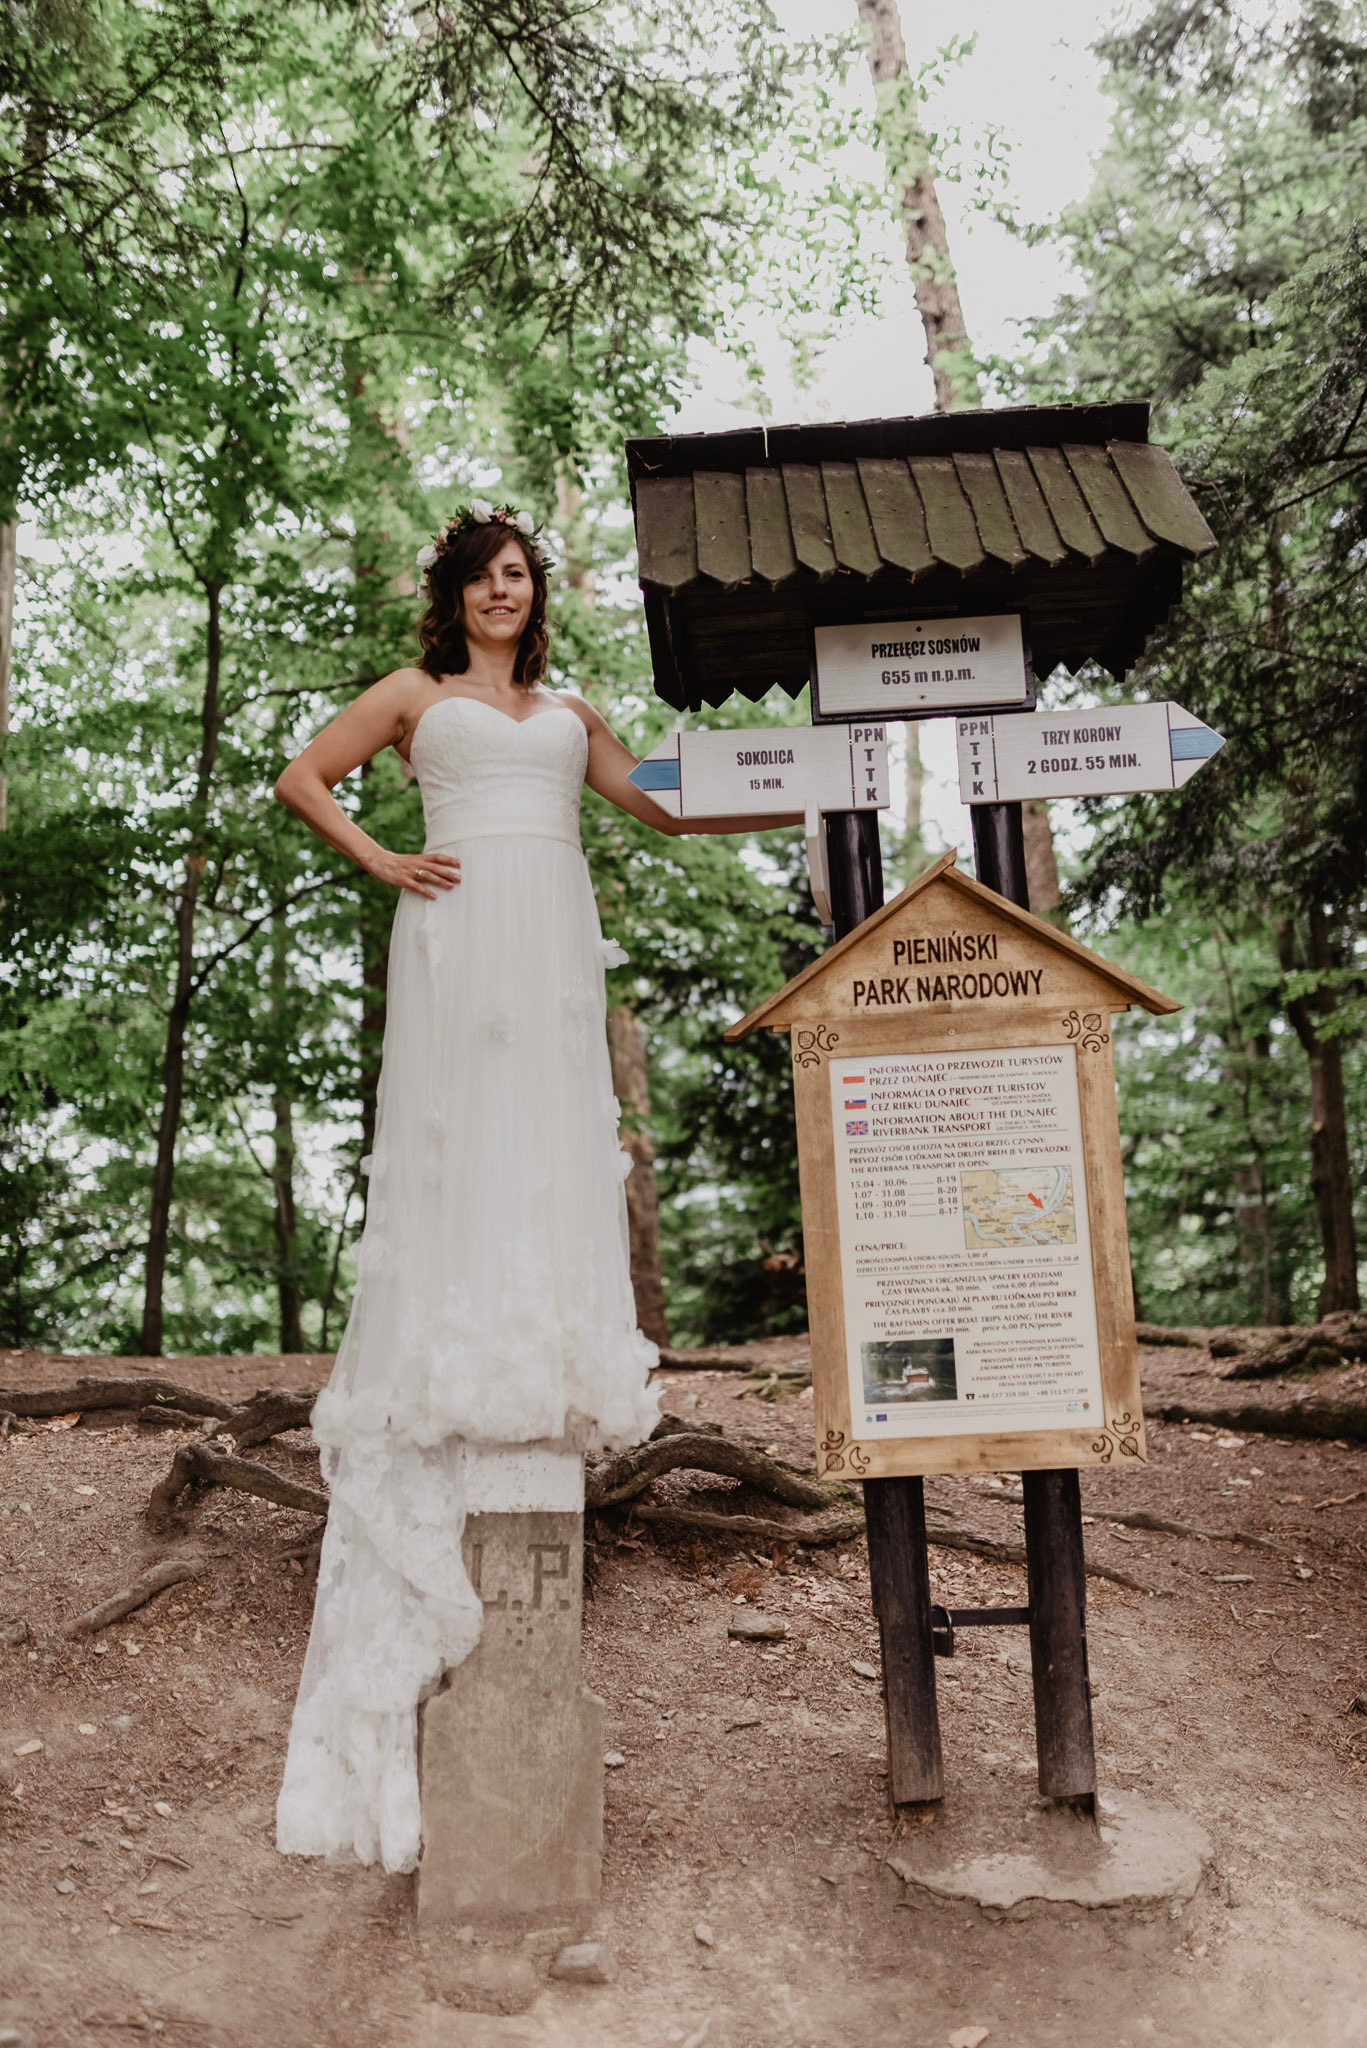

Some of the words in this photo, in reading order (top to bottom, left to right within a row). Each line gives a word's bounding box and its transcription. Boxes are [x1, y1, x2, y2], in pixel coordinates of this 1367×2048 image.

[871, 640, 925, 659] PRZEŁĘCZ
[928, 634, 981, 655] SOSNÓW
[881, 670, 911, 685] 655
[914, 670, 928, 683] m
[931, 668, 975, 683] n.p.m.
[854, 728, 884, 742] PPN
[959, 721, 989, 736] PPN
[1042, 730, 1070, 746] TRZY
[1073, 726, 1122, 744] KORONY
[736, 750, 794, 766] SOKOLICA
[1027, 760, 1037, 774] 2
[1040, 757, 1083, 773] GODZ.
[1085, 756, 1105, 770] 55
[1109, 753, 1141, 769] MIN.
[749, 779, 760, 790] 15
[763, 778, 784, 789] MIN.
[893, 931, 998, 966] PIENIŃSKI
[853, 977, 911, 1006] PARK
[917, 969, 1043, 1002] NARODOWY
[869, 1063, 934, 1075] INFORMACJA
[936, 1063, 944, 1071] O
[948, 1059, 1005, 1070] PRZEWOZIE
[1008, 1054, 1064, 1067] TURYSTÓW
[870, 1076, 900, 1085] PRZEZ
[902, 1074, 948, 1084] DUNAJEC
[871, 1088, 935, 1100] INFORMÁCIA
[950, 1086, 993, 1096] PREVOZE
[996, 1083, 1046, 1093] TURISTOV
[871, 1102, 889, 1111] CEZ
[893, 1100, 921, 1110] RIEKU
[925, 1098, 971, 1108] DUNAJEC
[872, 1114, 945, 1126] INFORMATION
[950, 1112, 985, 1121] ABOUT
[988, 1111, 1007, 1119] THE
[1010, 1108, 1058, 1118] DUNAJEC
[873, 1126, 930, 1137] RIVERBANK
[933, 1122, 991, 1133] TRANSPORT
[867, 1164, 909, 1173] RIVERBANK
[912, 1161, 956, 1170] TRANSPORT
[851, 1180, 874, 1188] 15.04
[884, 1179, 907, 1187] 30.06
[936, 1176, 956, 1184] 8-19
[854, 1191, 872, 1199] 1.07
[882, 1189, 905, 1197] 31.08
[938, 1186, 957, 1194] 8-20
[856, 1202, 873, 1210] 1.09
[882, 1200, 906, 1208] 30.09
[856, 1212, 874, 1220] 1.10
[883, 1210, 906, 1218] 31.10
[855, 1242, 907, 1252] CENA/PRICE:
[889, 1319, 930, 1327] RAFTSMEN
